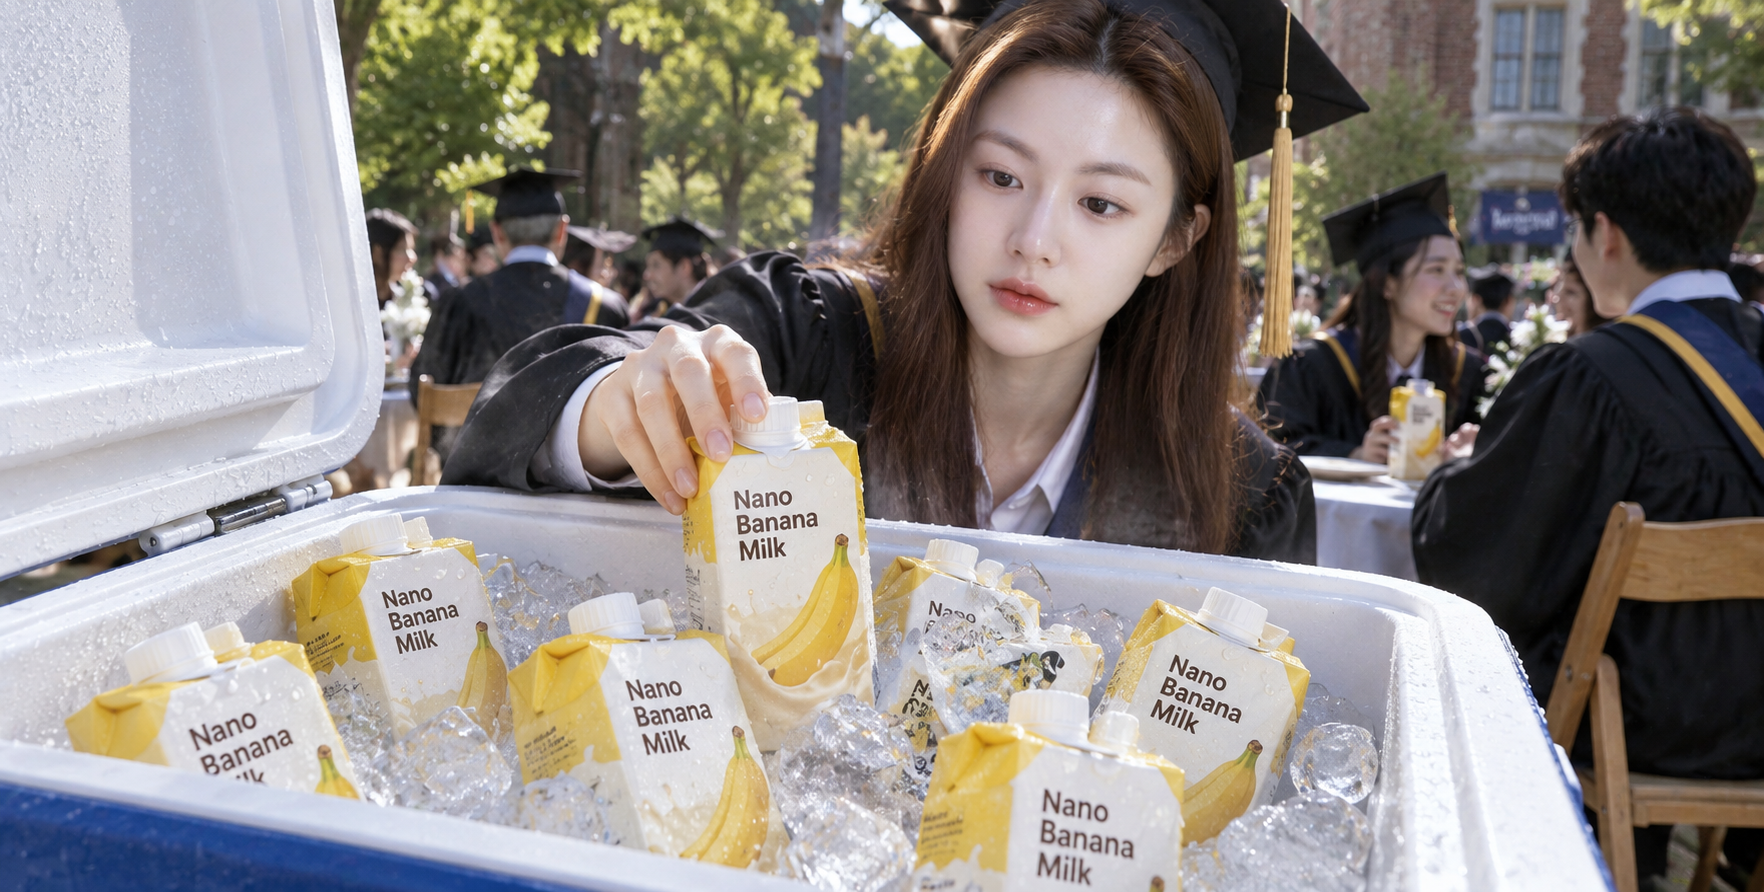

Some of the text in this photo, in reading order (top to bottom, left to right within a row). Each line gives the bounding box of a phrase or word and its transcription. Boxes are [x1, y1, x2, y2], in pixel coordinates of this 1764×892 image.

[733, 489, 793, 510] Nano
[736, 511, 819, 535] Banana
[739, 536, 787, 562] Milk
[381, 587, 433, 609] Nano
[387, 604, 460, 631] Banana
[394, 628, 439, 655] Milk
[1168, 653, 1227, 692] Nano
[625, 678, 683, 702] Nano
[1159, 675, 1243, 724] Banana
[632, 702, 714, 728] Banana
[1149, 698, 1200, 735] Milk
[188, 712, 258, 752] Nano
[641, 728, 692, 756] Milk
[199, 728, 295, 776] Banana
[1042, 787, 1109, 823] Nano
[1040, 818, 1135, 860] Banana
[1037, 851, 1093, 887] Milk
